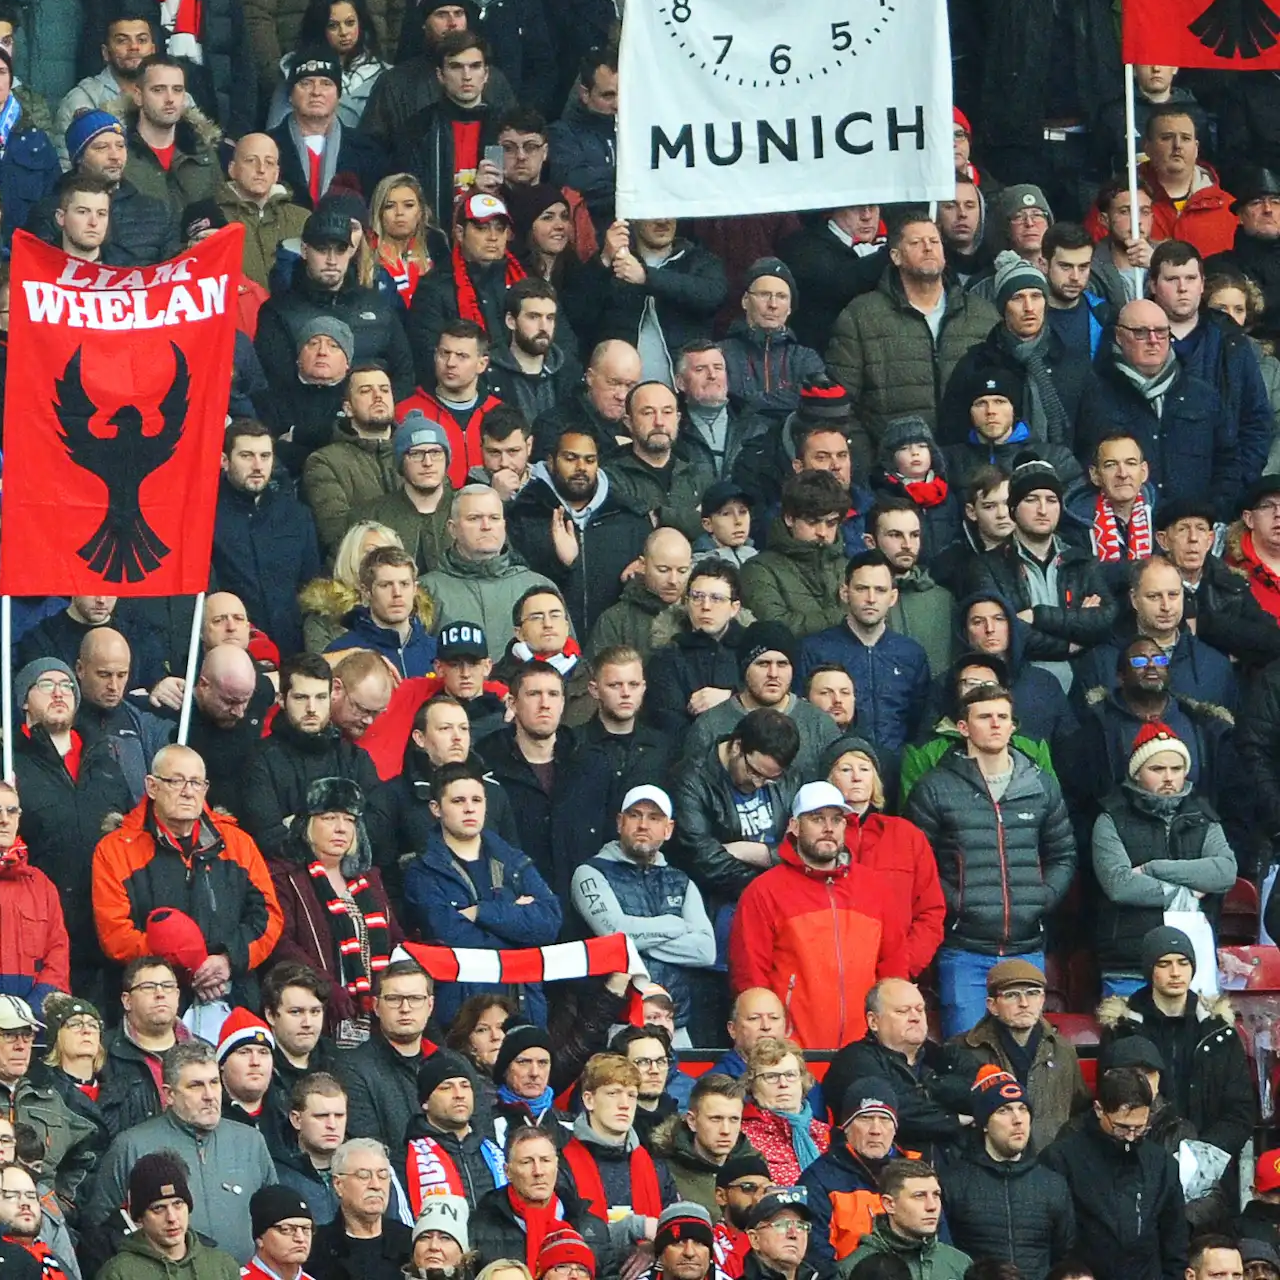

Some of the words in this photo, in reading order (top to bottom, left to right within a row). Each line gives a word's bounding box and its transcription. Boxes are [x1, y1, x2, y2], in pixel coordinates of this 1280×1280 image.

[712, 34, 734, 65] 7
[831, 21, 852, 51] 5
[770, 44, 792, 75] 6
[651, 105, 925, 170] MUNICH
[55, 256, 199, 291] LIAM
[22, 274, 230, 331] WHELAN
[441, 626, 482, 646] ICON
